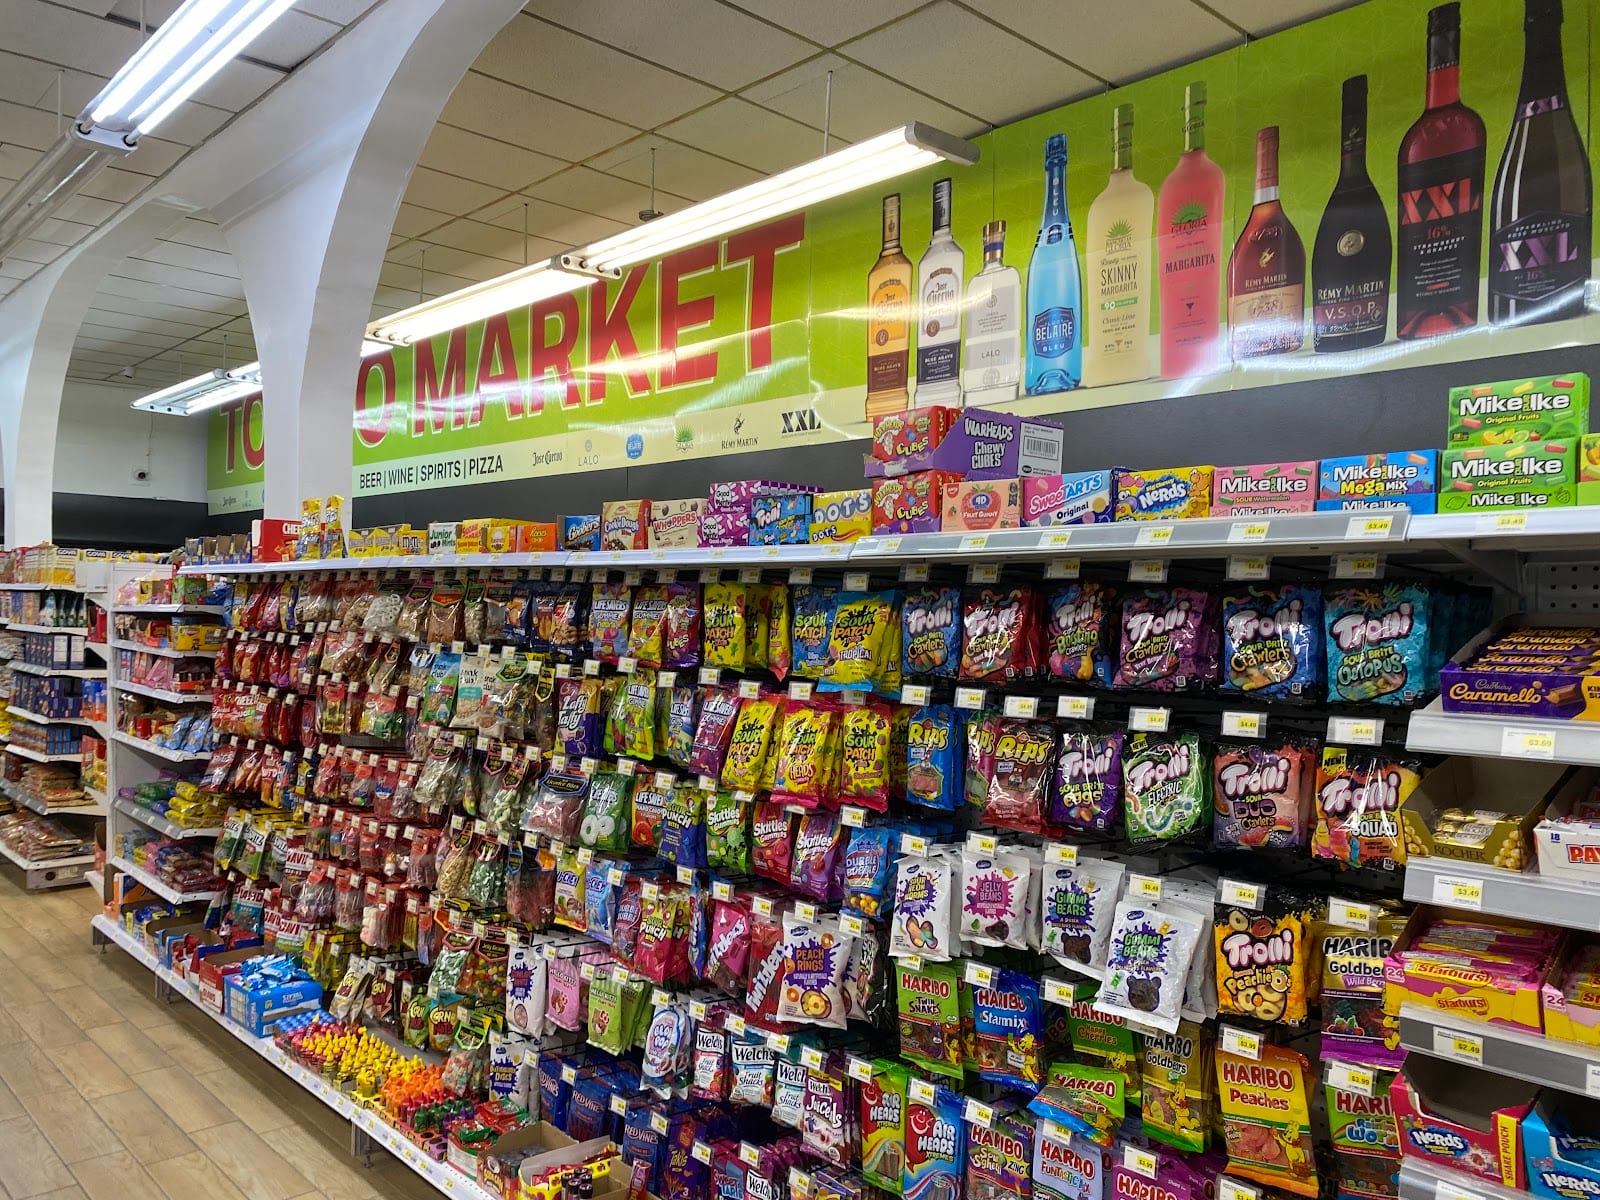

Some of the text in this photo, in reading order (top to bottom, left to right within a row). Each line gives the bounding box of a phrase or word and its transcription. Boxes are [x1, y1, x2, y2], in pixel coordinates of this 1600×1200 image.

[1402, 178, 1480, 226] XXL
[1499, 231, 1578, 272] XXL
[1165, 254, 1215, 274] MARGARITA
[1101, 263, 1138, 287] SKINNY
[1101, 283, 1138, 297] MARGARITA
[1344, 280, 1385, 296] MARTIN
[1036, 322, 1073, 342] BELAIRE
[981, 350, 1000, 360] LALO
[1042, 343, 1065, 352] BLEU
[1458, 393, 1570, 417] Mike Ike
[781, 408, 822, 434] XXL
[1485, 412, 1540, 425] Original Fruits
[964, 417, 1014, 441] WARHEADS
[974, 440, 1006, 457] Chewy
[468, 454, 504, 477] PIZZA
[577, 454, 600, 467] LALO
[971, 452, 1002, 470] CUBES
[1451, 457, 1563, 479] Mike Ike
[1333, 464, 1418, 482] Mike Ike
[1477, 476, 1532, 488] Original Fruits
[1220, 477, 1271, 495] Mike
[1277, 476, 1308, 493] Ike
[1340, 479, 1386, 496] Mega
[1471, 492, 1548, 507] Mike Ike
[1056, 501, 1090, 520] Original
[568, 518, 601, 541] Goobers
[653, 510, 698, 532] WHOPPERS
[429, 528, 453, 540] Junior
[794, 612, 827, 628] SOUR
[839, 612, 875, 628] SOUR
[908, 600, 953, 634] Trolli
[1056, 594, 1097, 628] Trolli
[704, 615, 735, 628] SOUR
[1126, 600, 1192, 643] Trolli
[1228, 600, 1302, 641] Trolli
[1333, 602, 1413, 651] Trolli
[704, 626, 735, 640] PATCH
[794, 625, 828, 640] PATCH
[834, 623, 874, 639] PATCH
[907, 638, 945, 658] Crawlers
[1126, 641, 1169, 664] Crawlers
[1368, 646, 1394, 660] BRITE
[1231, 646, 1291, 672] Crawlers
[1450, 682, 1542, 704] Caramello
[734, 729, 761, 743] SOUR
[846, 732, 875, 748] SOUR
[845, 747, 876, 761] PATCH
[790, 763, 813, 779] HEADS
[1059, 747, 1113, 783] Trolli
[1128, 745, 1191, 797] Trolli
[1219, 758, 1292, 800] Trolli
[1062, 790, 1103, 809] eggs
[1147, 779, 1184, 806] ELECTRIC
[1320, 773, 1401, 814] Trolli
[707, 808, 741, 826] Skittles
[1233, 799, 1277, 819] DUO
[662, 808, 693, 829] PUNCH
[1240, 816, 1276, 832] Crawlers
[754, 819, 788, 837] Skittles
[1550, 832, 1561, 841] 18
[797, 834, 833, 850] Skittles
[1434, 844, 1487, 862] ROCHER
[979, 890, 1003, 902] BEANS
[980, 881, 1002, 893] JELLY
[1457, 887, 1480, 897] $3.49
[1055, 890, 1088, 905] GUMMI
[1056, 903, 1087, 917] BEARS
[1349, 911, 1368, 920] $3.99
[640, 924, 668, 942] PUNCH
[1124, 934, 1161, 947] GUMMI
[796, 948, 825, 963] PEACH
[1123, 945, 1160, 959] BEARS
[1223, 928, 1295, 968] Trolli
[797, 960, 824, 972] RINGS
[1387, 967, 1404, 979] 24
[902, 973, 951, 999] HARIBO
[1346, 975, 1366, 986] Wild
[909, 1001, 942, 1015] SNAKES
[977, 988, 1028, 1012] HARIBO
[1437, 996, 1488, 1011] Starburst
[1547, 995, 1566, 1006] 24
[981, 1010, 1026, 1030] Starmix
[1077, 1027, 1118, 1046] Cherries
[1240, 1040, 1257, 1050] $3.99
[734, 1045, 776, 1062] Welch's
[1457, 1043, 1480, 1054] $2.49
[1146, 1051, 1188, 1076] Goldbears
[1222, 1061, 1294, 1091] HARIBO
[1351, 1074, 1370, 1086] $3.99
[1053, 1072, 1117, 1099] HARIBO
[572, 1090, 586, 1105] RED
[881, 1092, 901, 1109] AIR
[1229, 1087, 1291, 1111] Peaches
[869, 1106, 900, 1122] HEADS
[624, 1124, 659, 1145] RED VINES
[932, 1120, 956, 1140] AIR
[917, 1134, 955, 1154] HEADS
[971, 1124, 1024, 1161] HARIBO
[1500, 1125, 1515, 1181] SHARE POUCH
[1008, 1161, 1025, 1175] ZING
